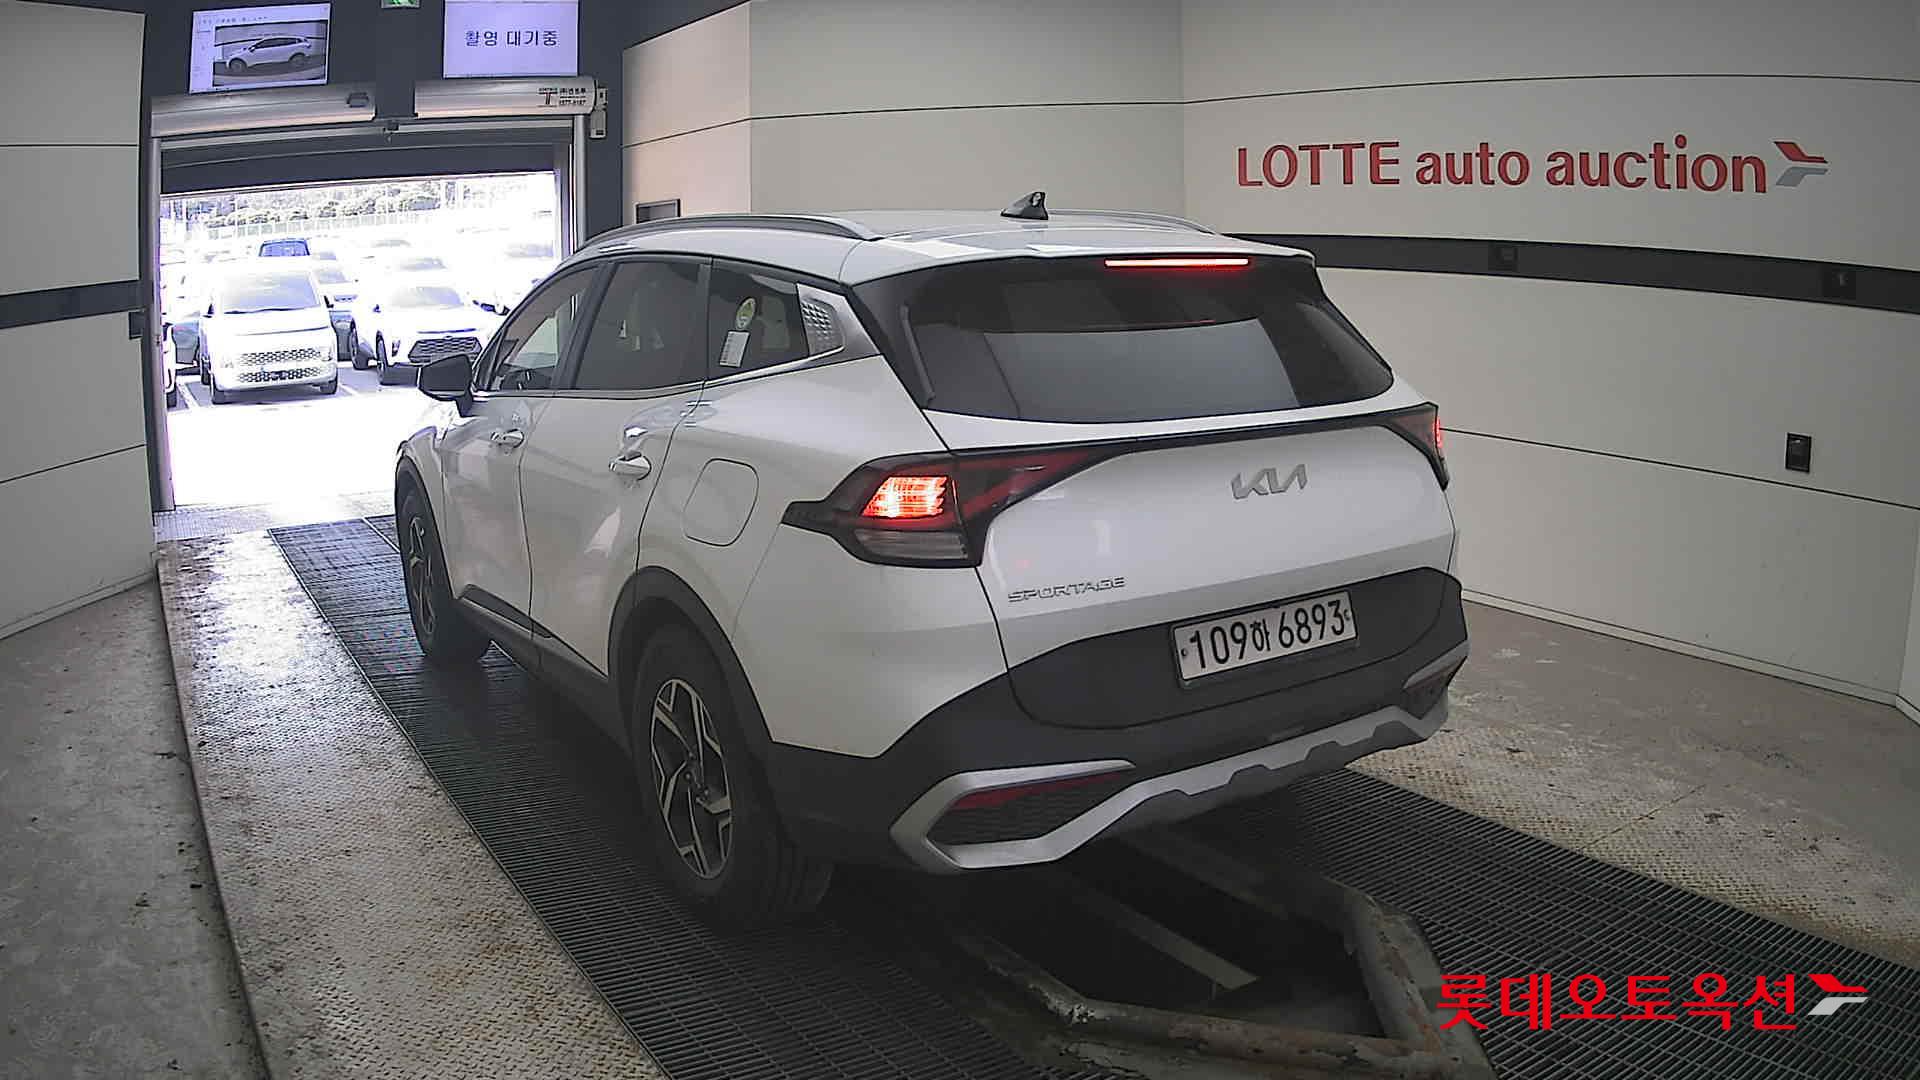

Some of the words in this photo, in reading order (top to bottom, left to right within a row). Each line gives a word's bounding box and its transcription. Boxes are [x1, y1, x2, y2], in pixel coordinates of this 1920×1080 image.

[465, 30, 498, 47] 촬영
[506, 29, 557, 47] 대기중
[1237, 141, 1400, 188] LOTTE
[1415, 142, 1531, 186] auto
[1546, 134, 1767, 193] auction
[1008, 577, 1125, 603] SPORTAGE
[1189, 619, 1272, 669] 109하
[1278, 600, 1345, 648] 6893
